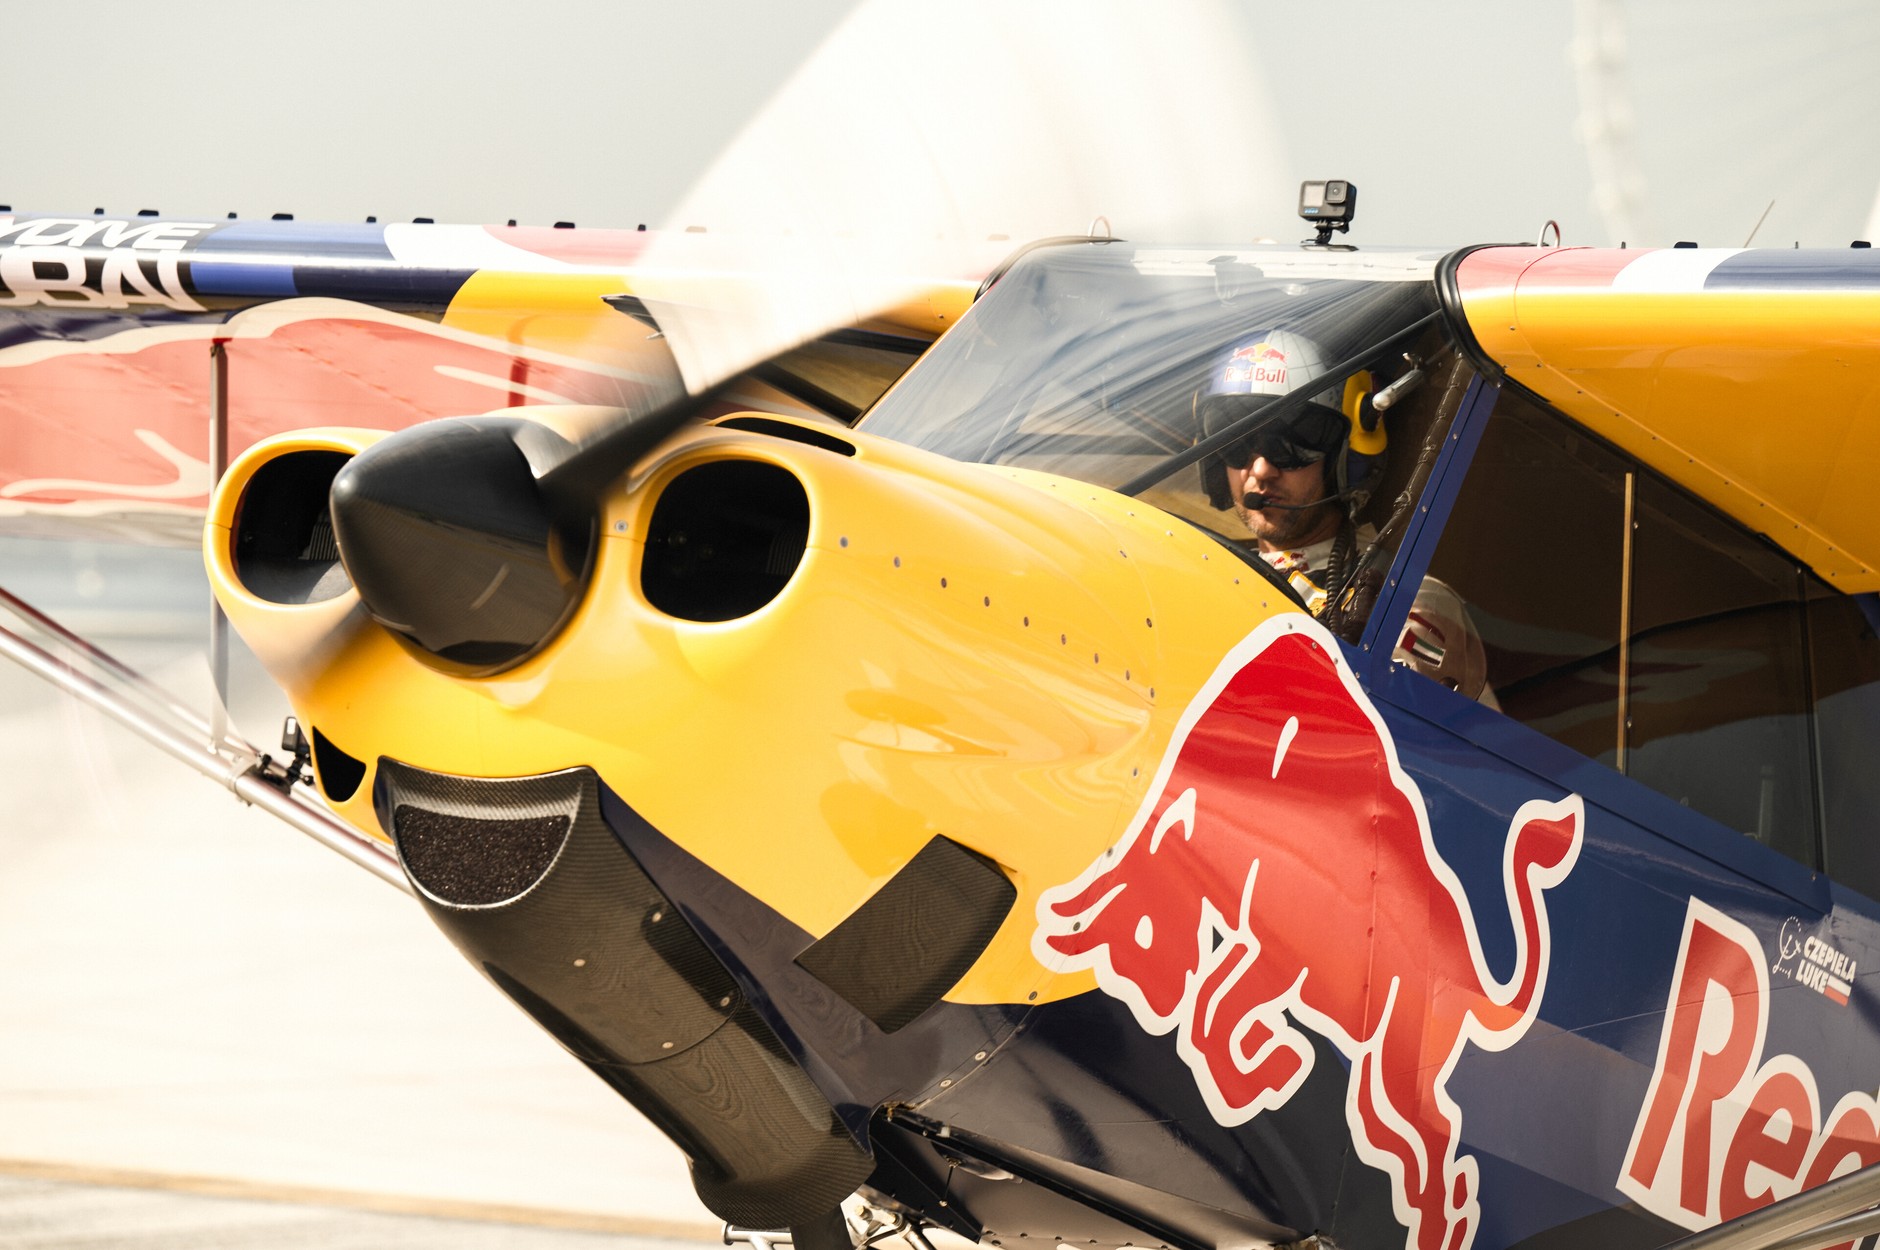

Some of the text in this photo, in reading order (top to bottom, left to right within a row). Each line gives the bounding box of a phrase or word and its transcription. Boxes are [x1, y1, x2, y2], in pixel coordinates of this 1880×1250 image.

[1225, 366, 1286, 383] Rd Bull
[1795, 959, 1829, 994] LUKE
[1803, 935, 1857, 983] CZEPIELA
